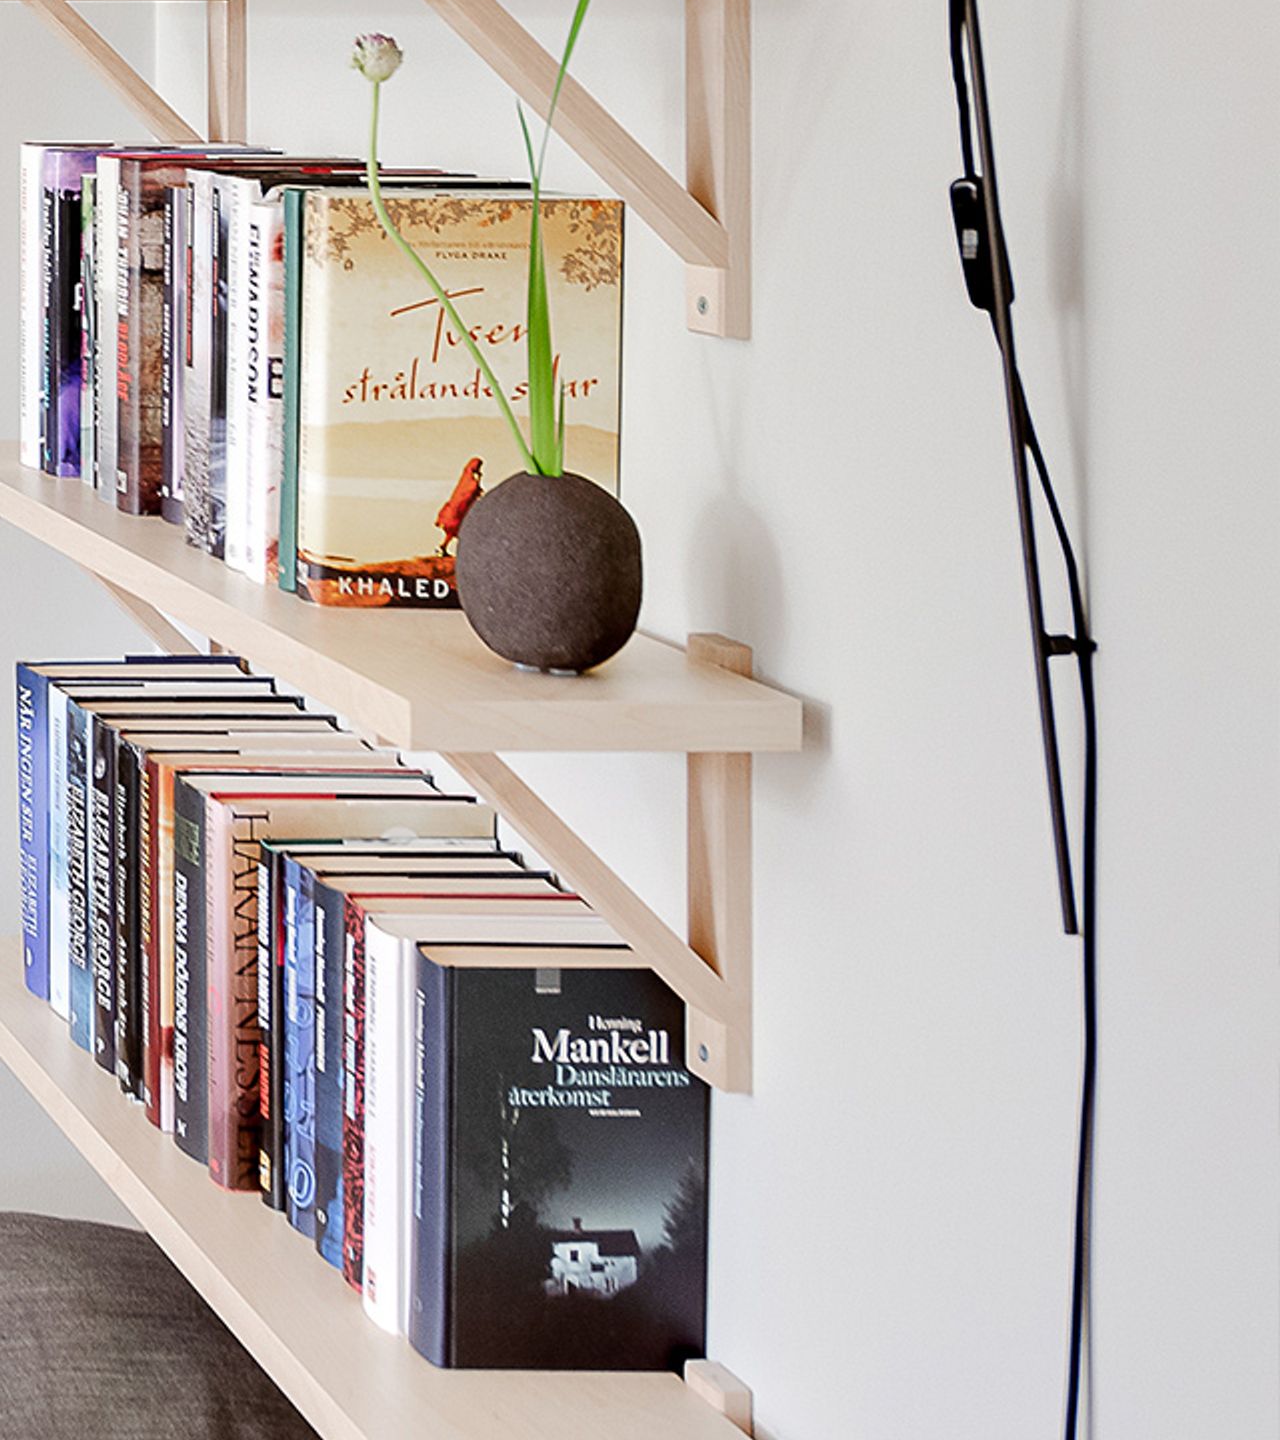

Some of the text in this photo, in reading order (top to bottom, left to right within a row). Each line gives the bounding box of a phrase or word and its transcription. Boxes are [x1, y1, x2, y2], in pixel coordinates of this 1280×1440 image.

[117, 184, 130, 318] JOHAN THEORIN
[472, 251, 507, 260] DRAKE
[511, 353, 599, 402] slar
[338, 575, 451, 599] KHALED
[19, 732, 33, 804] INGEN
[20, 804, 33, 844] SER
[70, 782, 87, 971] ELIZABETH GEORGE
[95, 788, 111, 1012] ELIZABETH GEORGE
[174, 870, 189, 1103] DENNA DÖDENS KROPP
[257, 944, 270, 1031] MANKELL
[531, 1028, 669, 1064] Mankell
[587, 1015, 643, 1034] Henning
[507, 1085, 612, 1108] återkomst
[556, 1063, 691, 1088] Danslärarens
